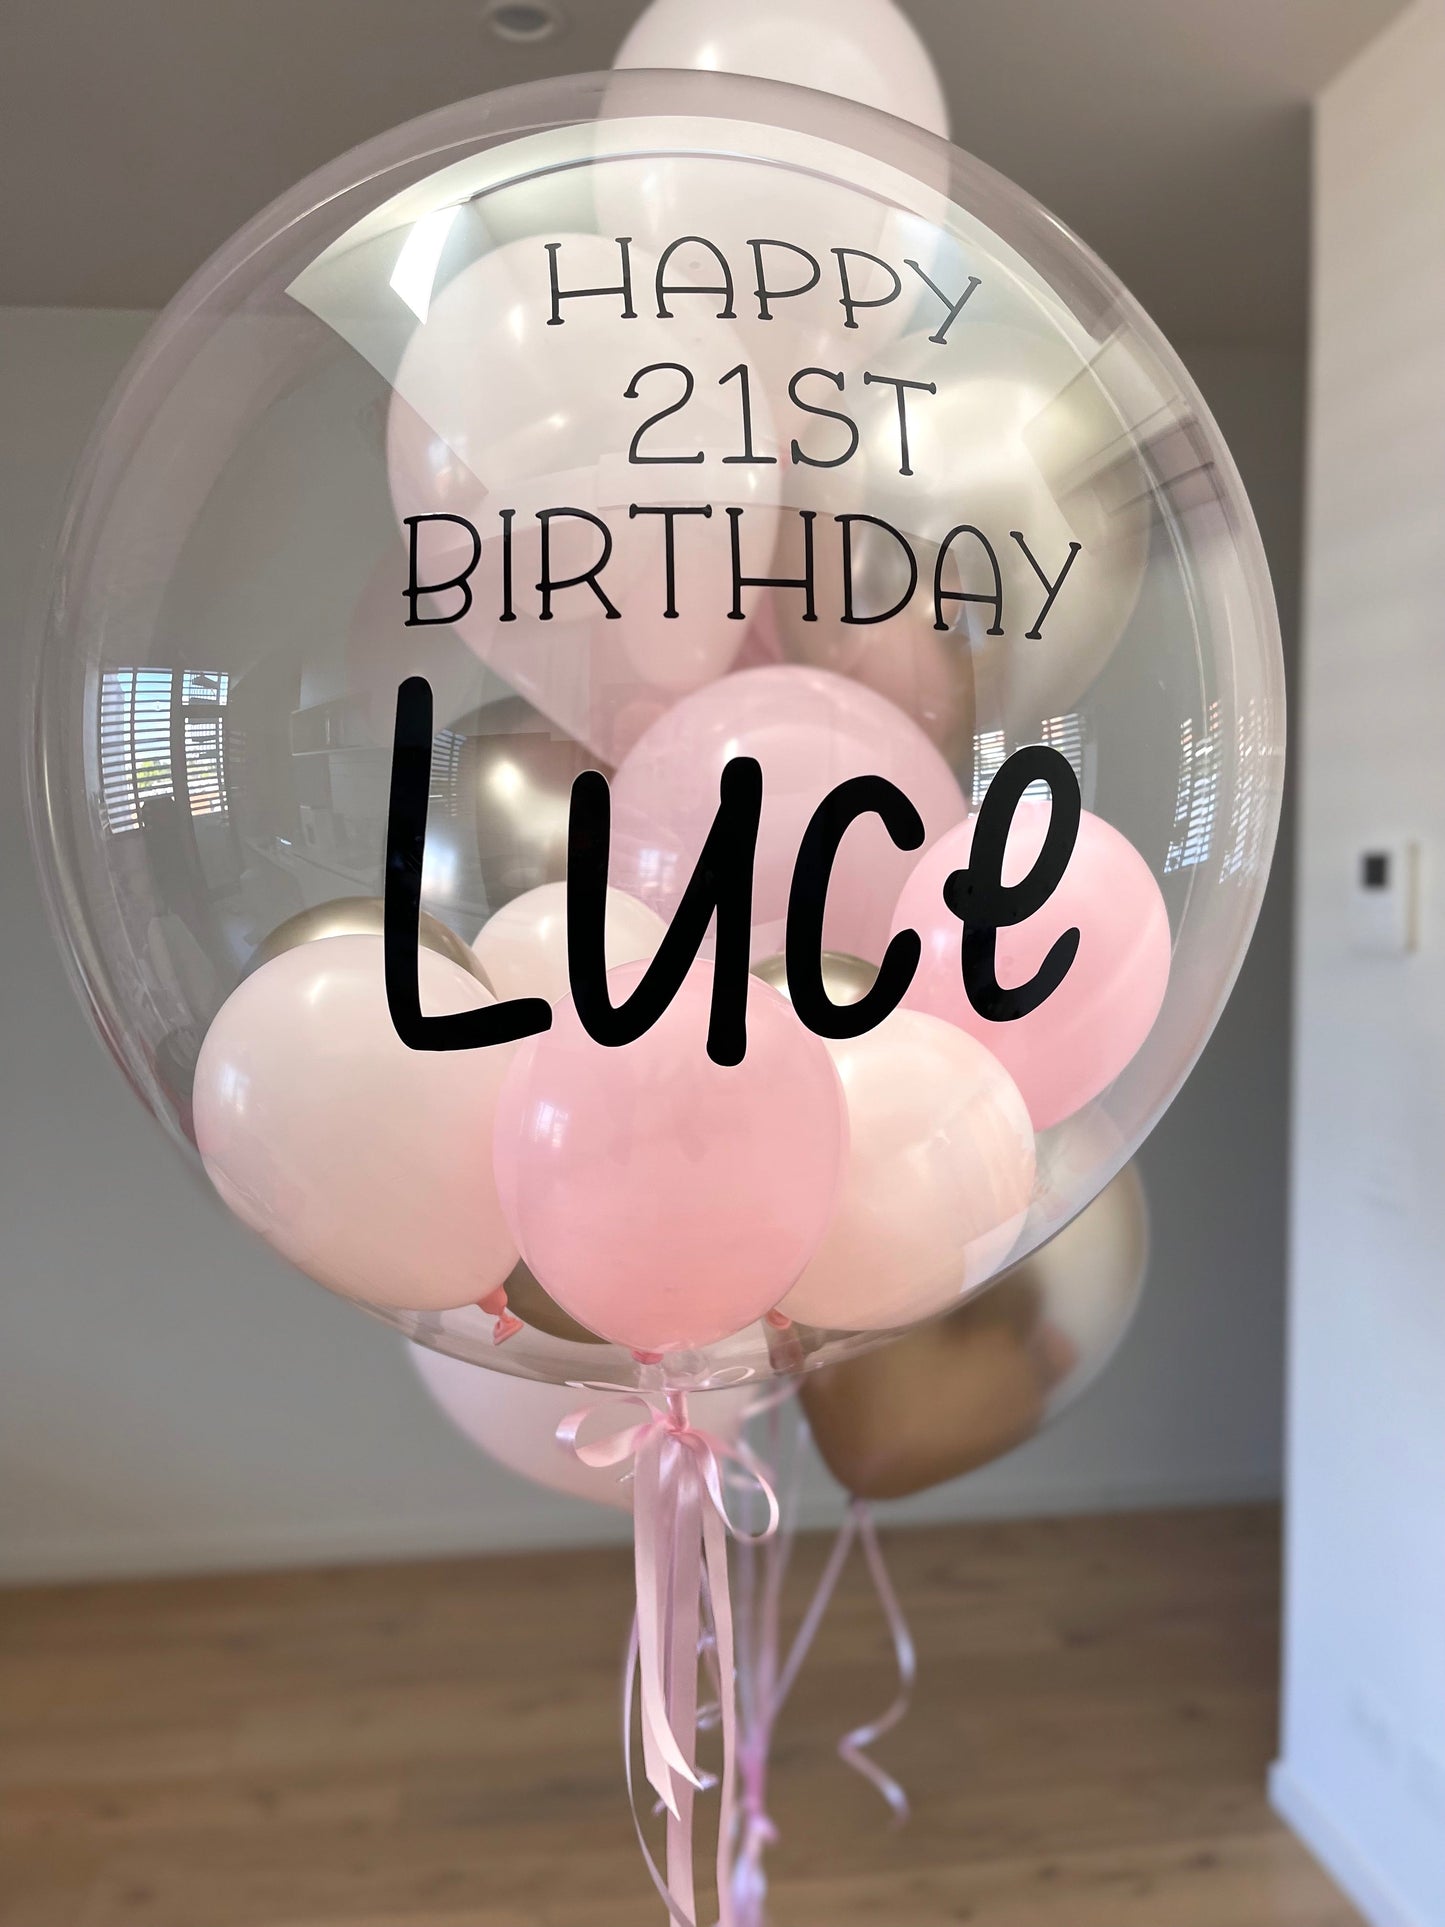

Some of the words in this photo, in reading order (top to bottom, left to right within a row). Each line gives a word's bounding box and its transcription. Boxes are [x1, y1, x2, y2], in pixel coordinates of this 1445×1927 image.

[543, 235, 983, 345] HAPPY
[622, 362, 938, 477] 21ST
[401, 503, 1083, 640] BIRTHDAY
[384, 676, 1082, 1067] Luce
